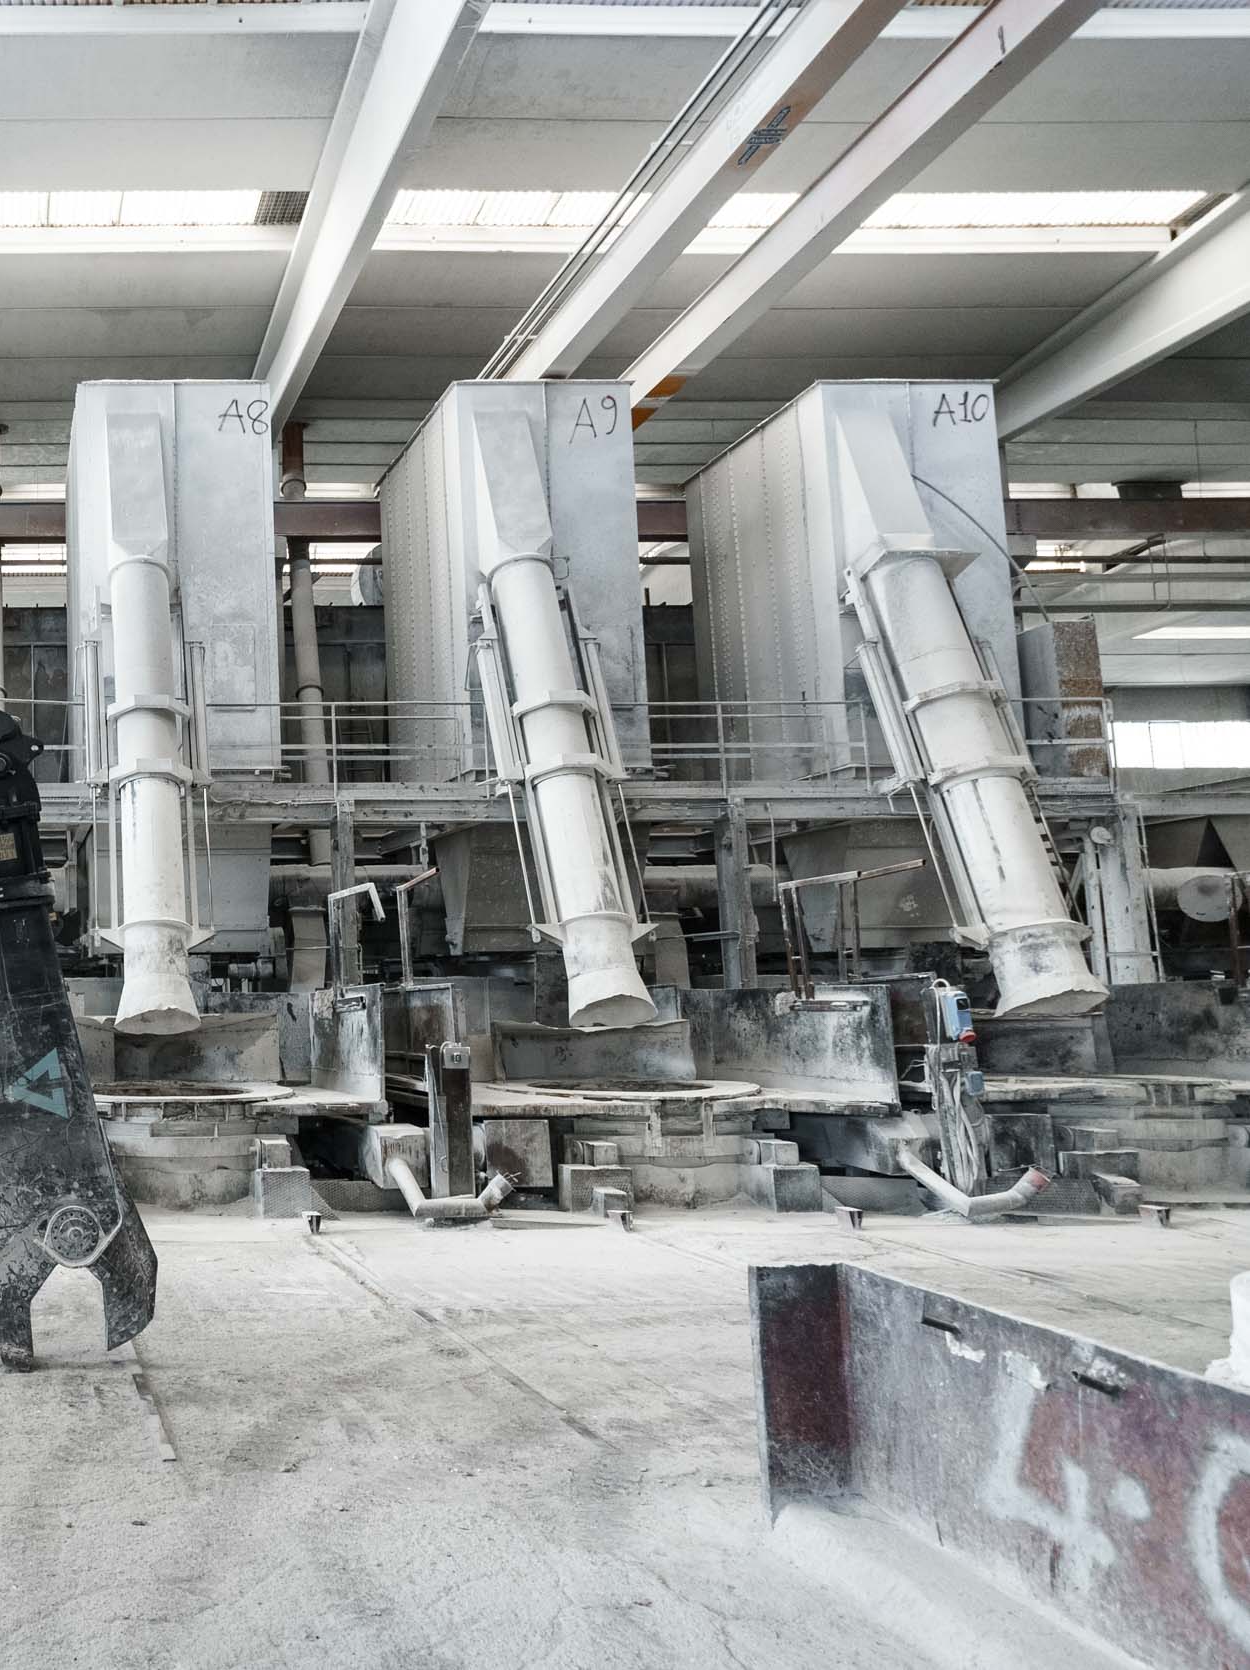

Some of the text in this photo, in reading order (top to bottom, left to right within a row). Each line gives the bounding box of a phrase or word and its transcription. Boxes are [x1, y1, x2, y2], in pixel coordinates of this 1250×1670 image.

[217, 398, 269, 435] A8
[569, 394, 618, 444] A9
[932, 391, 990, 428] A10
